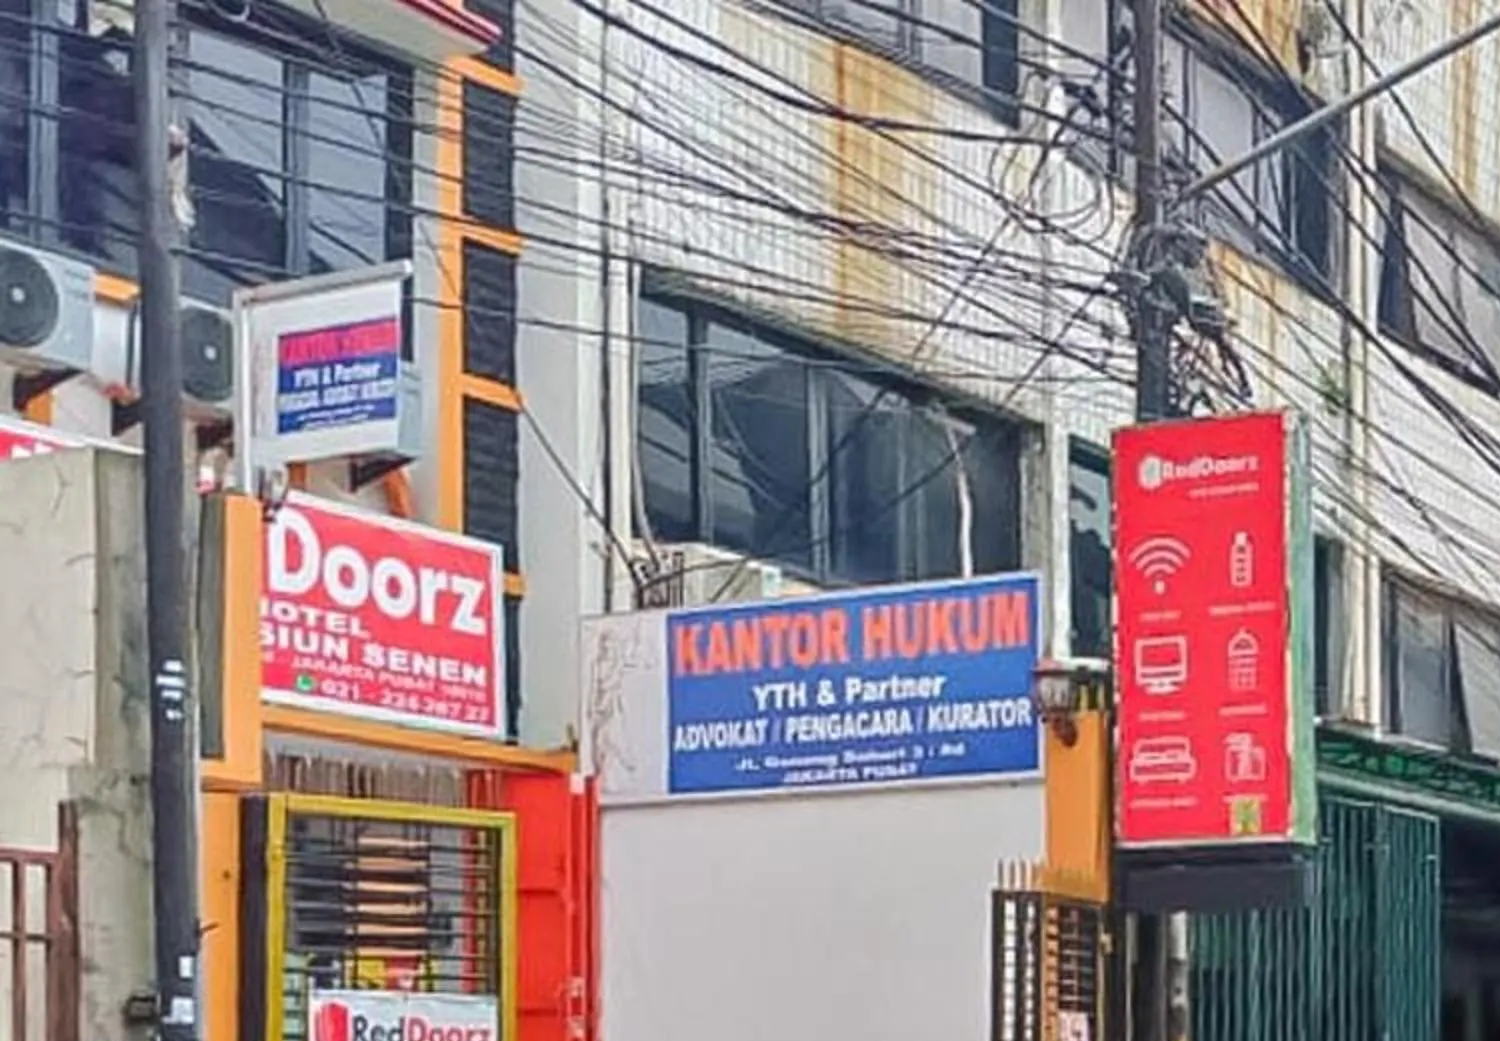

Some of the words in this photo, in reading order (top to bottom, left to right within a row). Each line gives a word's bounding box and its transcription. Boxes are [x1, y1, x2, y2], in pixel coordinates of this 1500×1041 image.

[268, 507, 487, 636] Doorz
[674, 607, 849, 677] KANTOR
[863, 591, 1030, 661] HUKUM
[362, 643, 487, 686] SENEN
[752, 682, 807, 712] YTH
[816, 680, 835, 705] &
[844, 674, 948, 705] Partner
[674, 718, 768, 752] ADVOKAT
[785, 706, 913, 743] PENGACARA
[927, 697, 1032, 734] KURATOR
